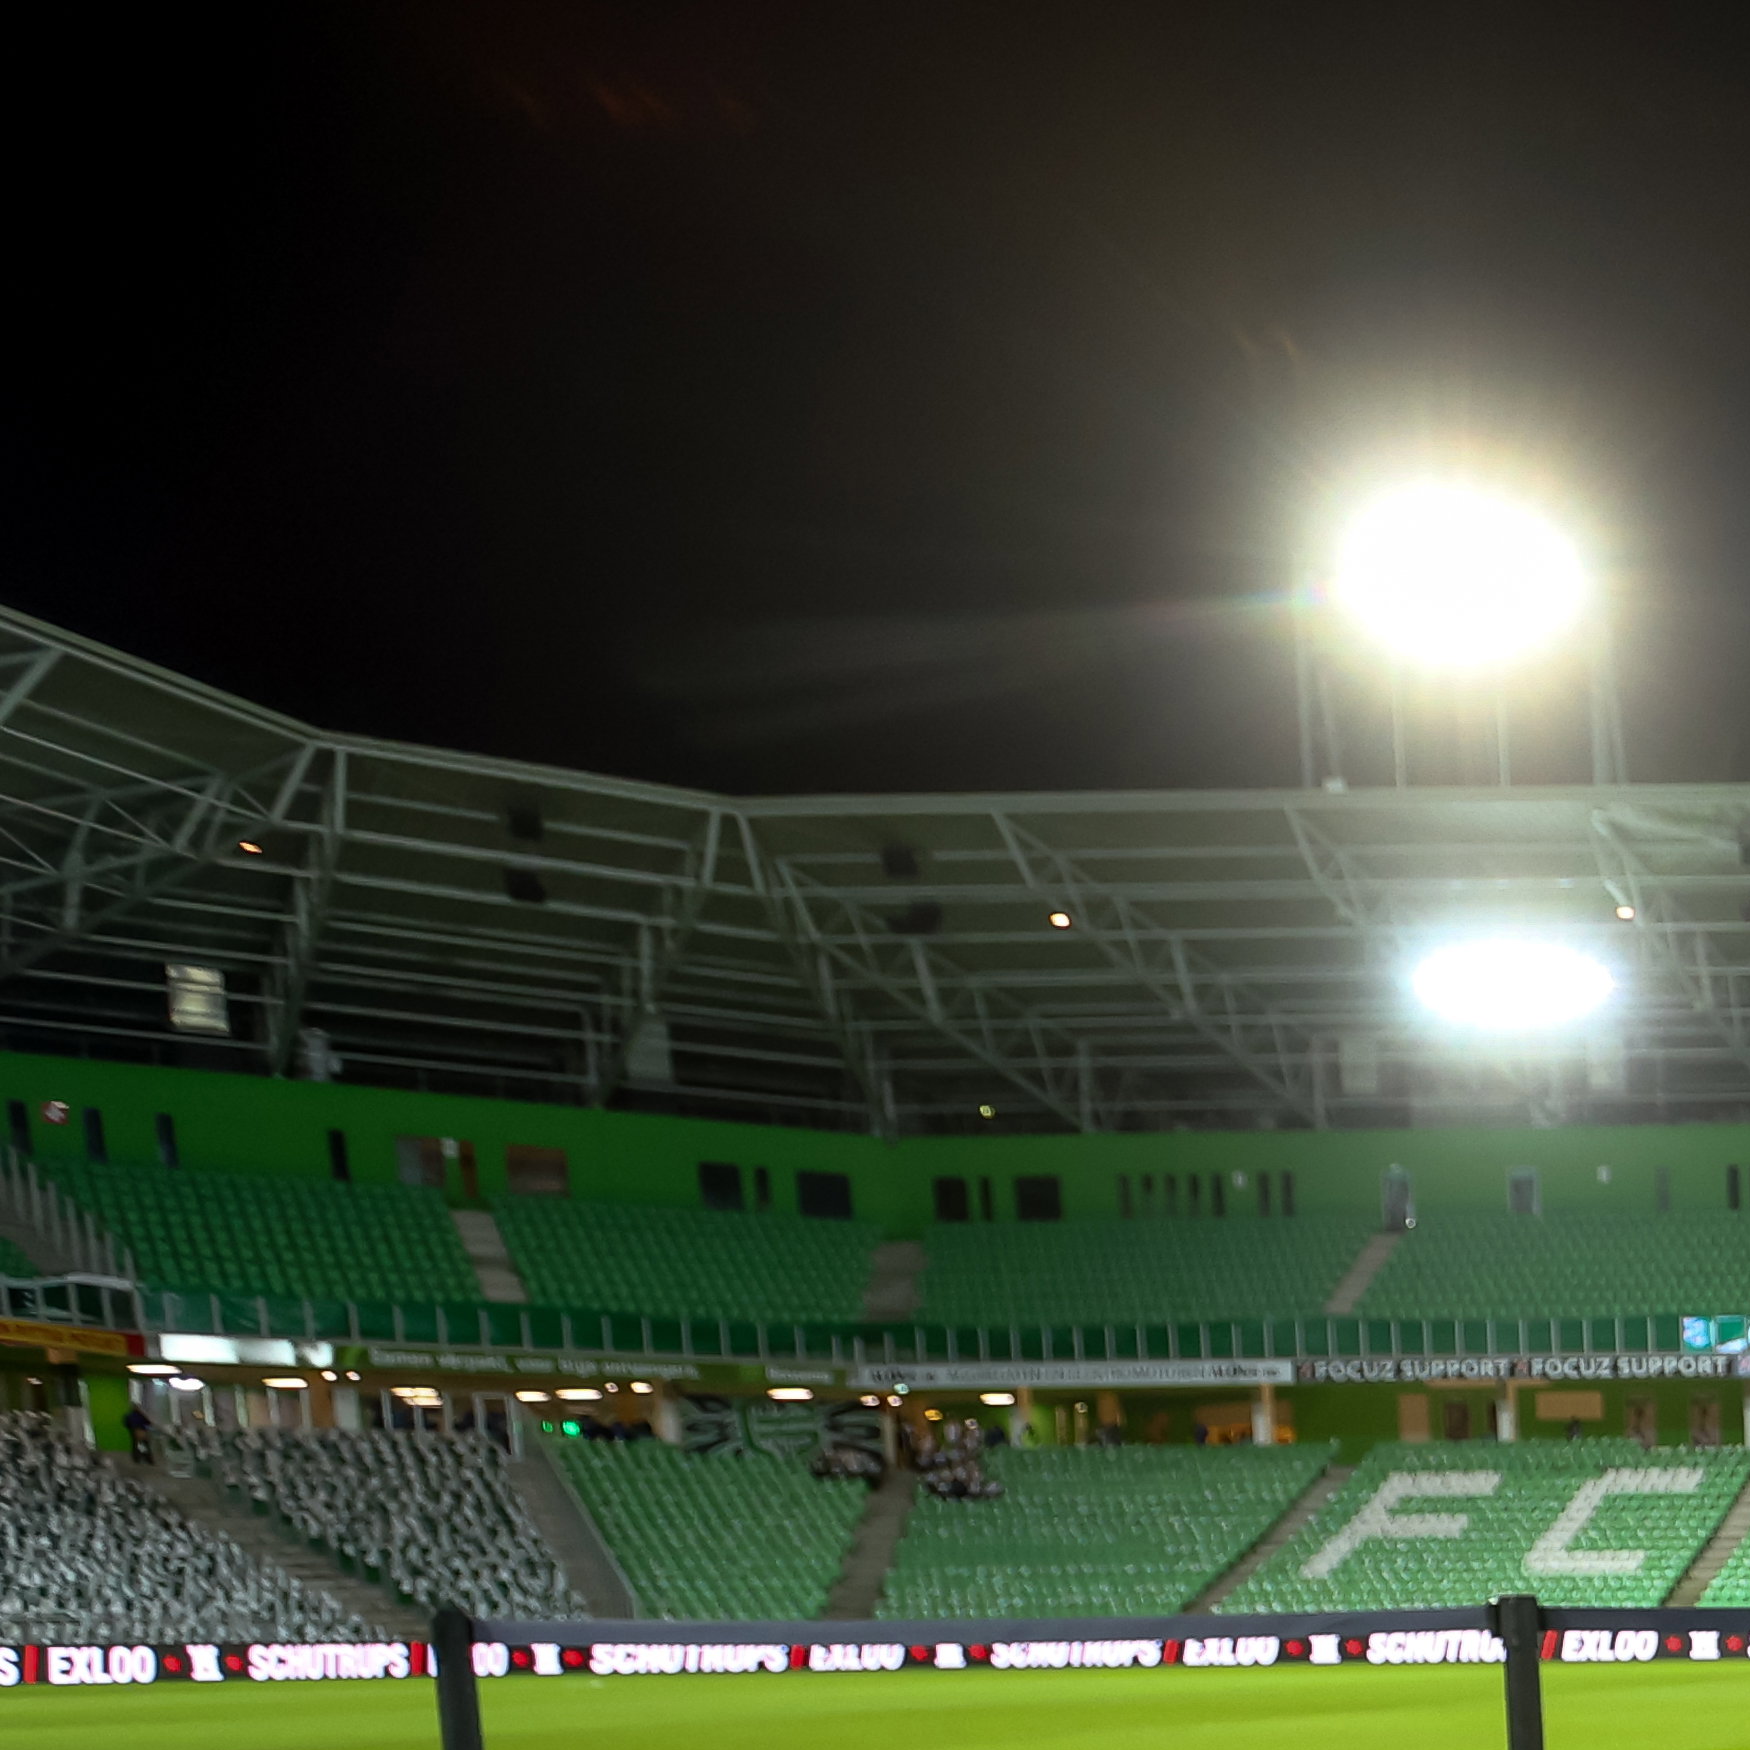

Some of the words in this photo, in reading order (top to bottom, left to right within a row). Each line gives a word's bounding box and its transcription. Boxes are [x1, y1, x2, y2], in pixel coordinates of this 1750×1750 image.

[1315, 1358, 1397, 1383] FOCUZ
[1399, 1357, 1509, 1381] SUPPORT
[1531, 1356, 1612, 1379] FOCUZ
[1616, 1355, 1728, 1379] SUPPORT
[1301, 1467, 1704, 1578] FC
[1561, 1630, 1659, 1662] EXLOO
[46, 1645, 157, 1684] EXLOO
